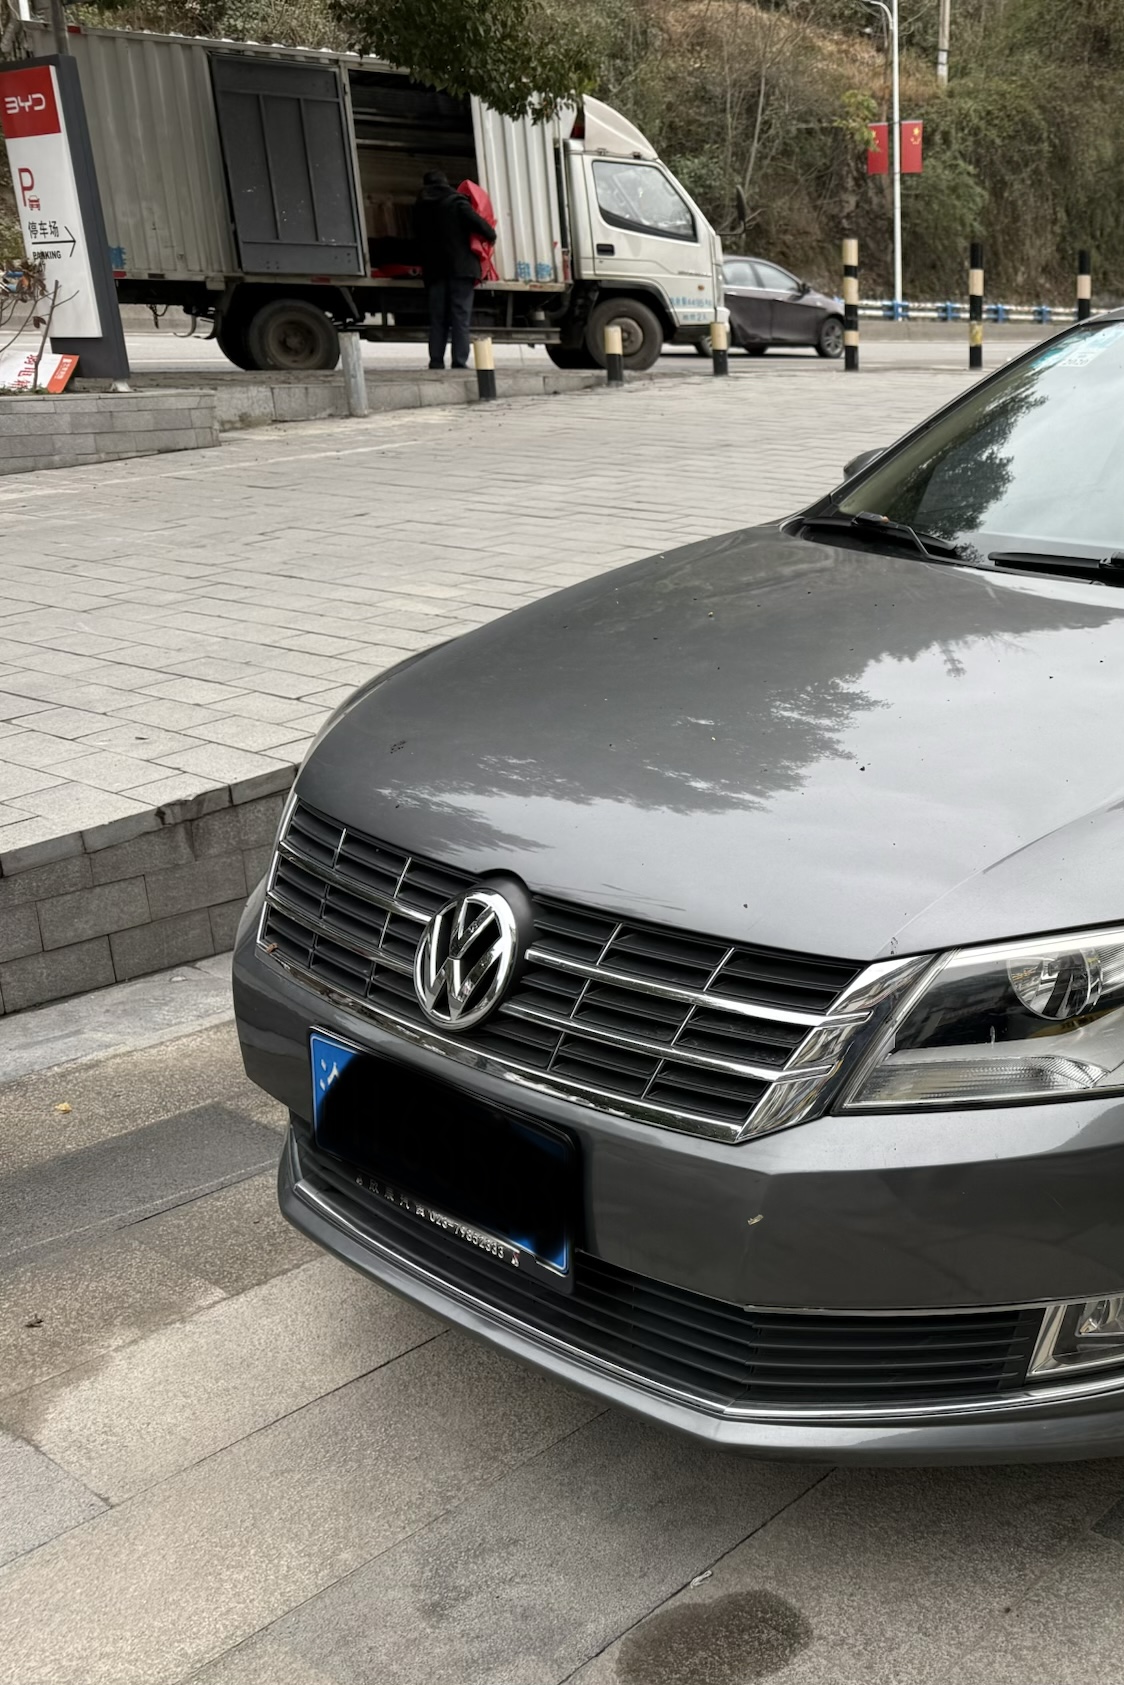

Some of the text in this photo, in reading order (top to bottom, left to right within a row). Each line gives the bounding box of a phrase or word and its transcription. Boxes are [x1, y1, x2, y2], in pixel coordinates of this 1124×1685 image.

[4, 92, 46, 114] BYD
[28, 220, 60, 239] 停车场
